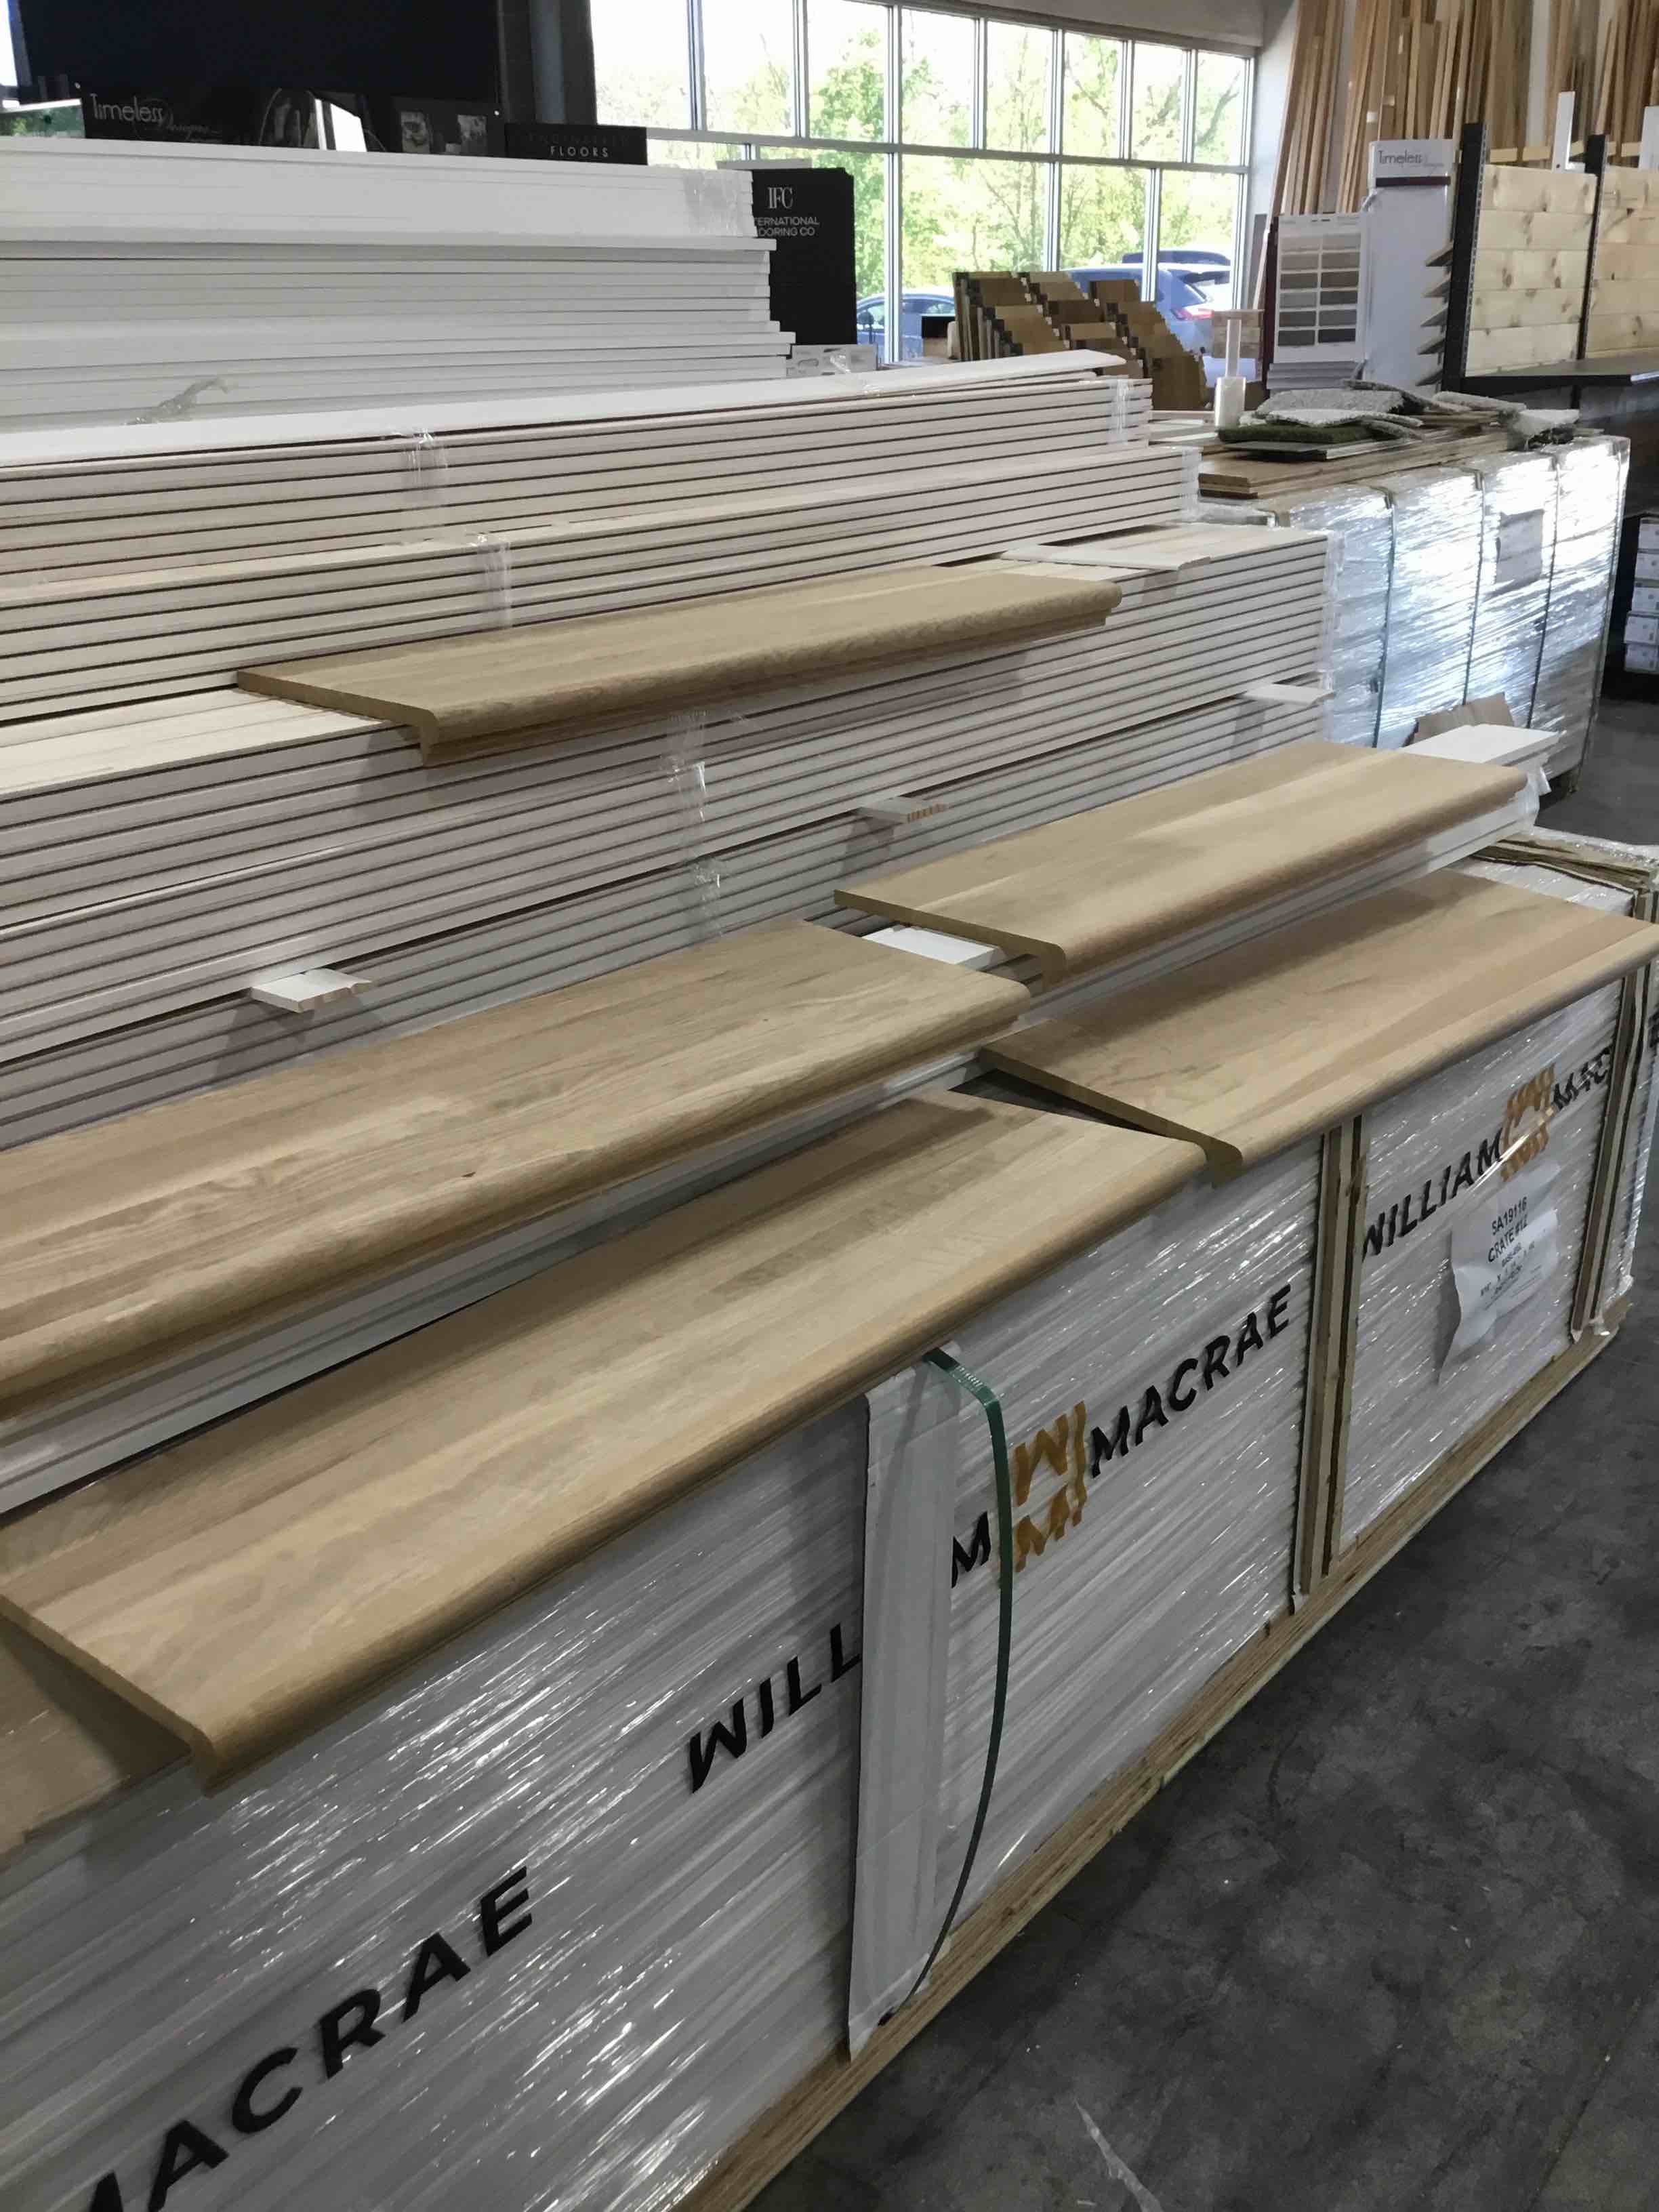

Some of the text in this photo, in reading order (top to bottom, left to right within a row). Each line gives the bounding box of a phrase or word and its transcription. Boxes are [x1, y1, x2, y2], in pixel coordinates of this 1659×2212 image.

[89, 93, 163, 123] Timeless
[550, 145, 609, 158] FLOORS
[767, 186, 794, 209] IFC
[799, 226, 815, 237] CO
[1488, 1227, 1515, 1263] CRATE
[1090, 1284, 1291, 1478] MACRAE
[88, 1866, 533, 2212] ACRAE
